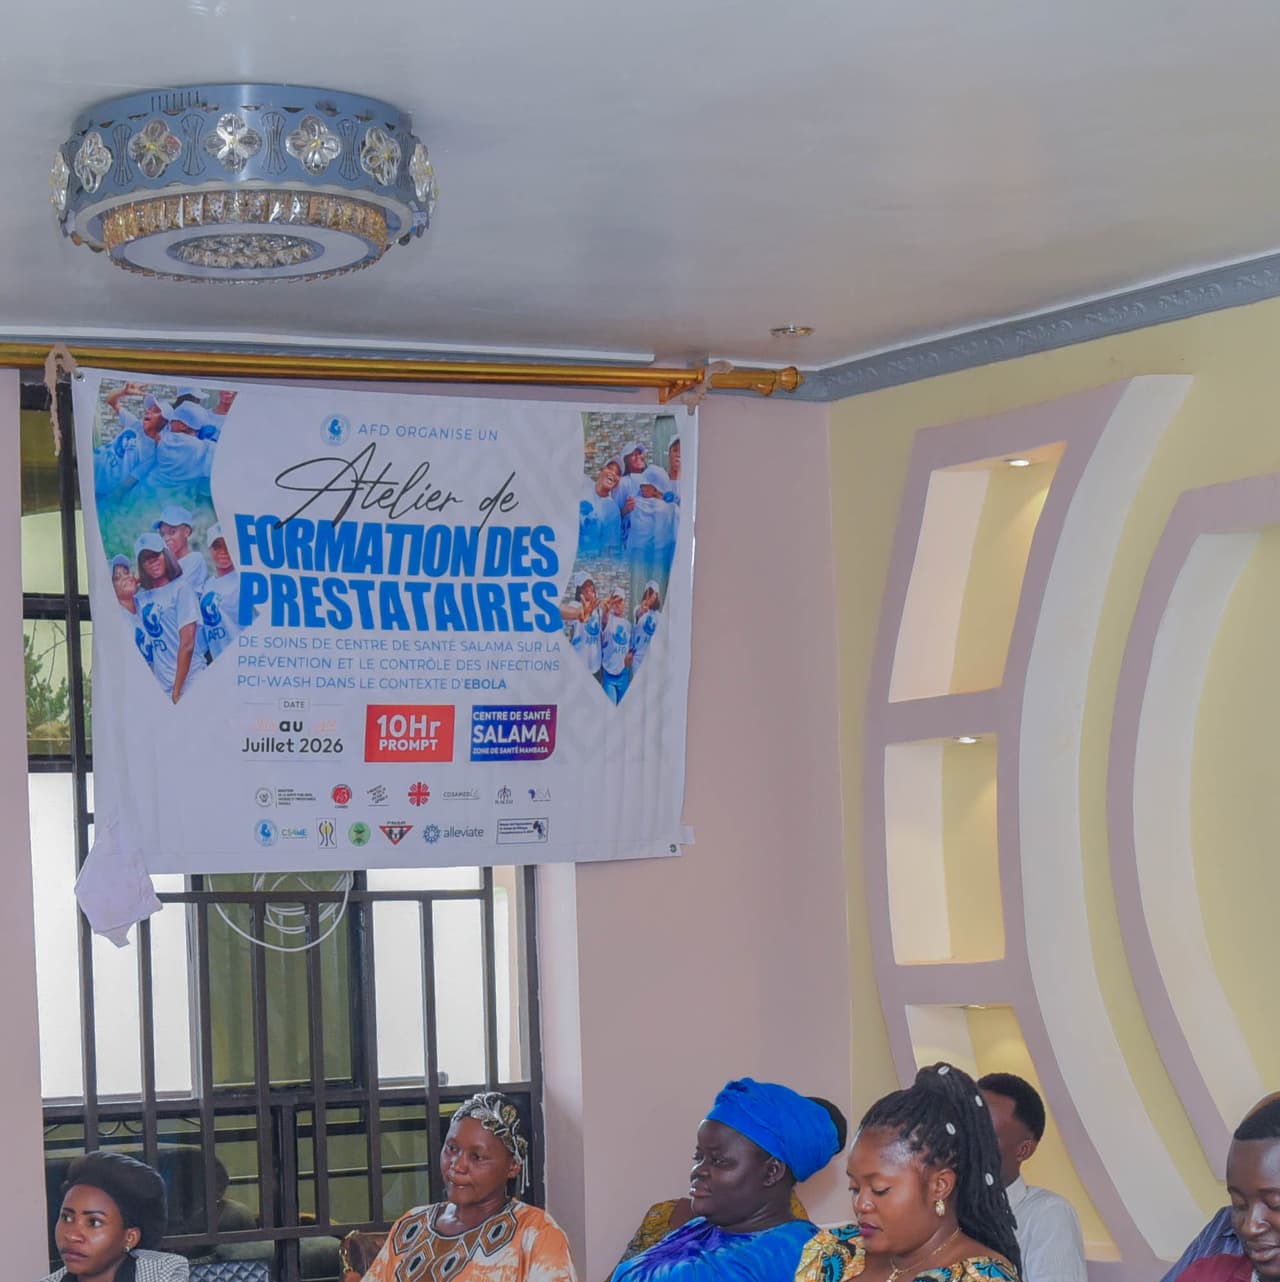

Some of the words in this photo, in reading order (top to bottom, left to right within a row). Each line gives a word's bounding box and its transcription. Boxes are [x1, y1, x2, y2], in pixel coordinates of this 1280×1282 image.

[358, 423, 390, 437] AFD
[395, 425, 473, 441] ORGANISE
[478, 429, 499, 441] UN
[274, 442, 463, 530] Atelier
[477, 471, 520, 537] de
[234, 514, 478, 577] FORMATION
[483, 524, 559, 578] DES
[237, 572, 563, 633] PRESTATAIRES
[238, 636, 257, 648] DE
[264, 636, 308, 649] SOINS
[312, 637, 331, 650] DE
[335, 638, 390, 651] CENTRE
[392, 639, 411, 651] DE
[461, 640, 514, 652] SALAMA
[517, 641, 542, 653] SUR
[545, 641, 561, 653] LA
[238, 654, 332, 669] PRÉVENTION
[337, 658, 353, 670] ET
[359, 659, 374, 670] LE
[379, 655, 451, 671] CONTRÔLE
[456, 659, 481, 671] DES
[486, 659, 560, 672] INFECTIONS
[237, 675, 311, 688] PCI-WASH
[316, 676, 356, 689] DANS
[359, 677, 374, 689] LE
[379, 677, 447, 690] CONTEXTE
[451, 677, 507, 690] D'EBOLA
[283, 701, 305, 709] DATE
[472, 711, 508, 721] CENTRE
[509, 711, 522, 721] DE
[522, 708, 551, 720] SANTÉ
[279, 720, 304, 732] au
[376, 714, 441, 738] 10Hr
[472, 724, 550, 743] SALAMA
[242, 737, 294, 753] Juillet
[299, 738, 344, 753] 2026
[378, 739, 439, 751] PROMPT
[443, 825, 484, 838] alleviate
